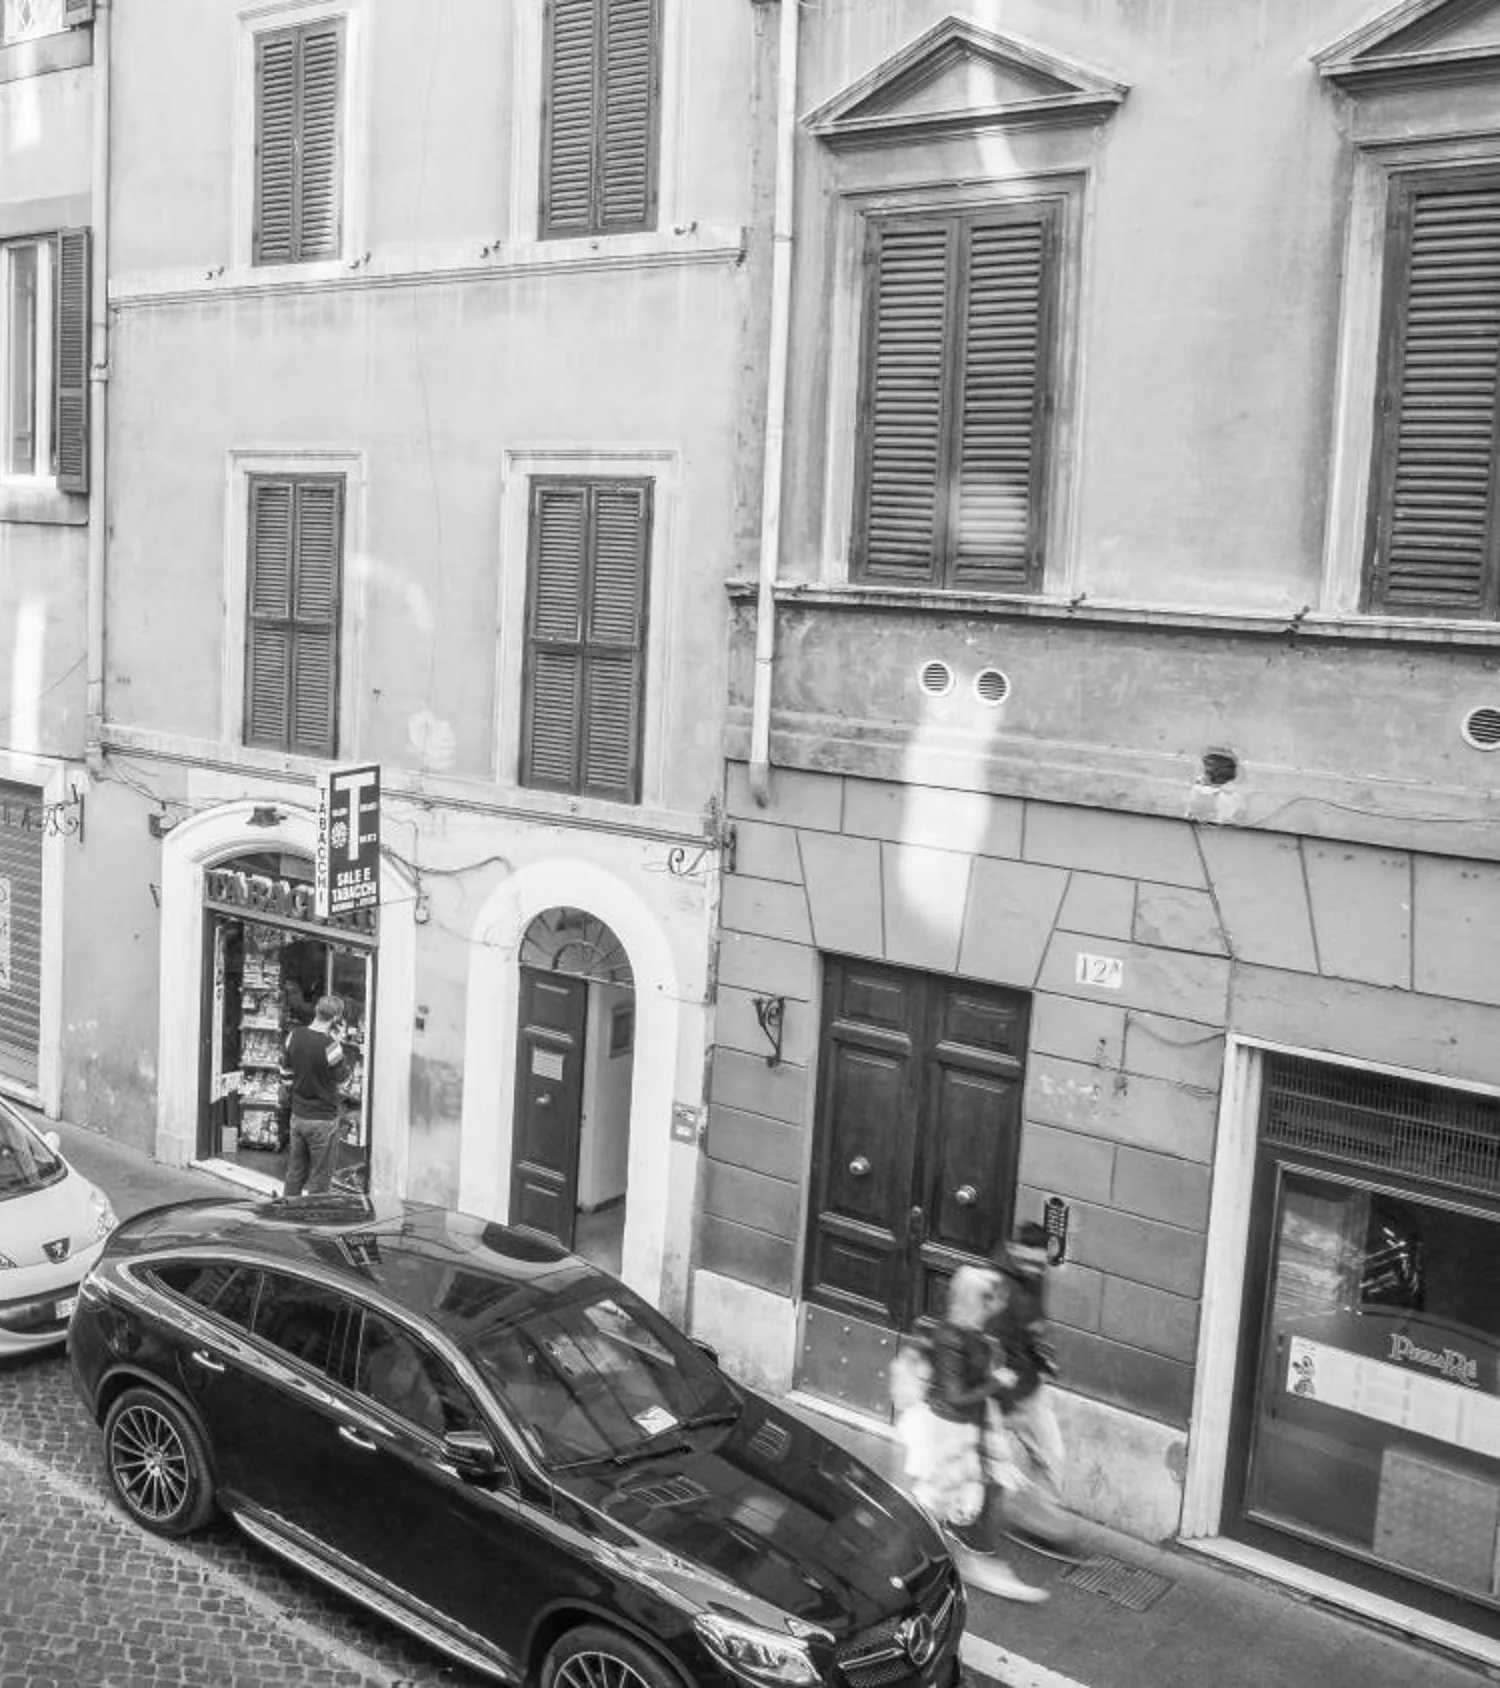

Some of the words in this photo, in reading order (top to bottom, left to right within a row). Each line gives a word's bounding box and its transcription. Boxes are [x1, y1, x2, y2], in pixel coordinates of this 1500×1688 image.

[317, 787, 327, 903] TABACCHI
[335, 771, 376, 860] T
[337, 869, 361, 887] SALE
[364, 867, 371, 881] E
